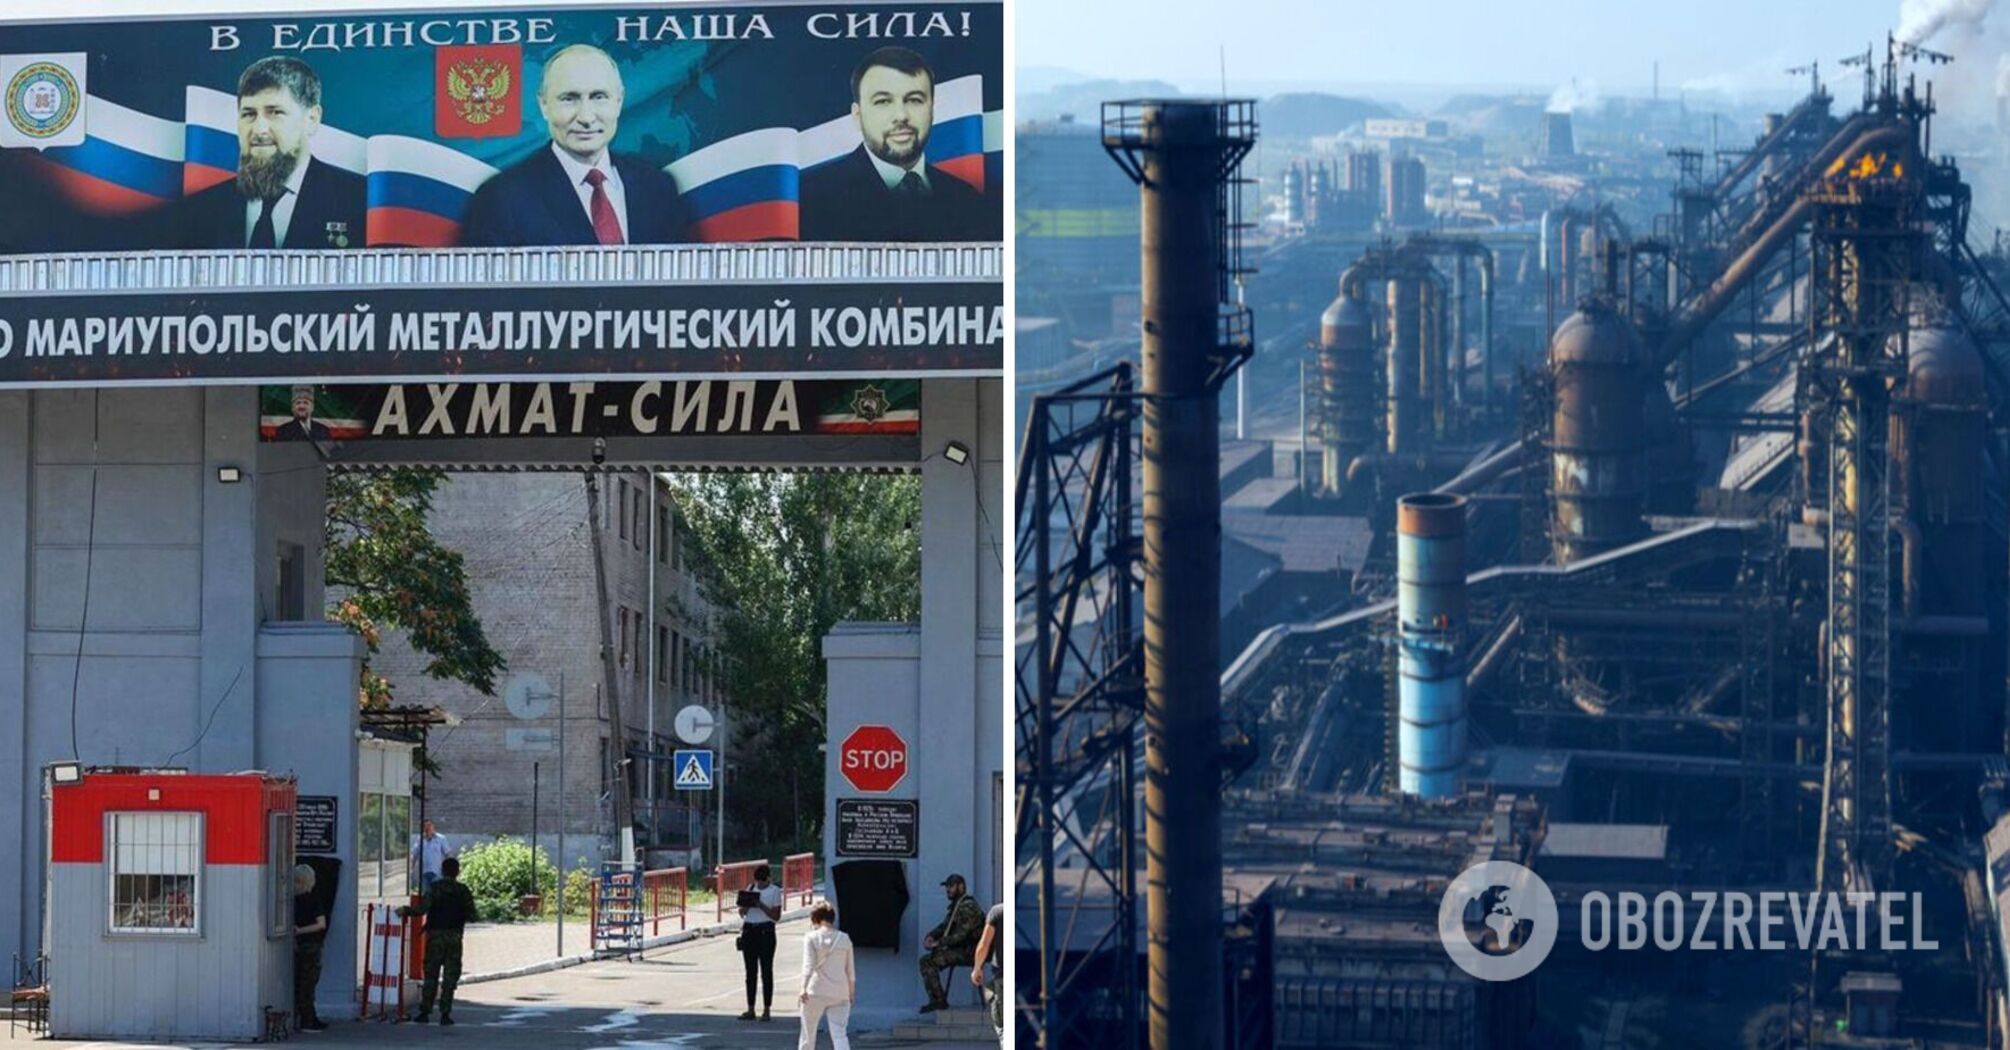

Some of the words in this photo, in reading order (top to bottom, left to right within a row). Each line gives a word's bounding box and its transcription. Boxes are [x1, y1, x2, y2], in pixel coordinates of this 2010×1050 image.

[209, 26, 240, 51] В
[272, 18, 557, 52] ЕДИНСТВЕ
[616, 13, 776, 42] НАША
[806, 11, 971, 40] СИЛА!
[25, 303, 375, 357] МАРИУПОЛЬСКИЙ
[388, 299, 796, 351] МЕТАЛЛУРГИЧЕСКИЙ
[371, 380, 802, 436] АХМАТ-СИЛА
[846, 749, 904, 769] STOP
